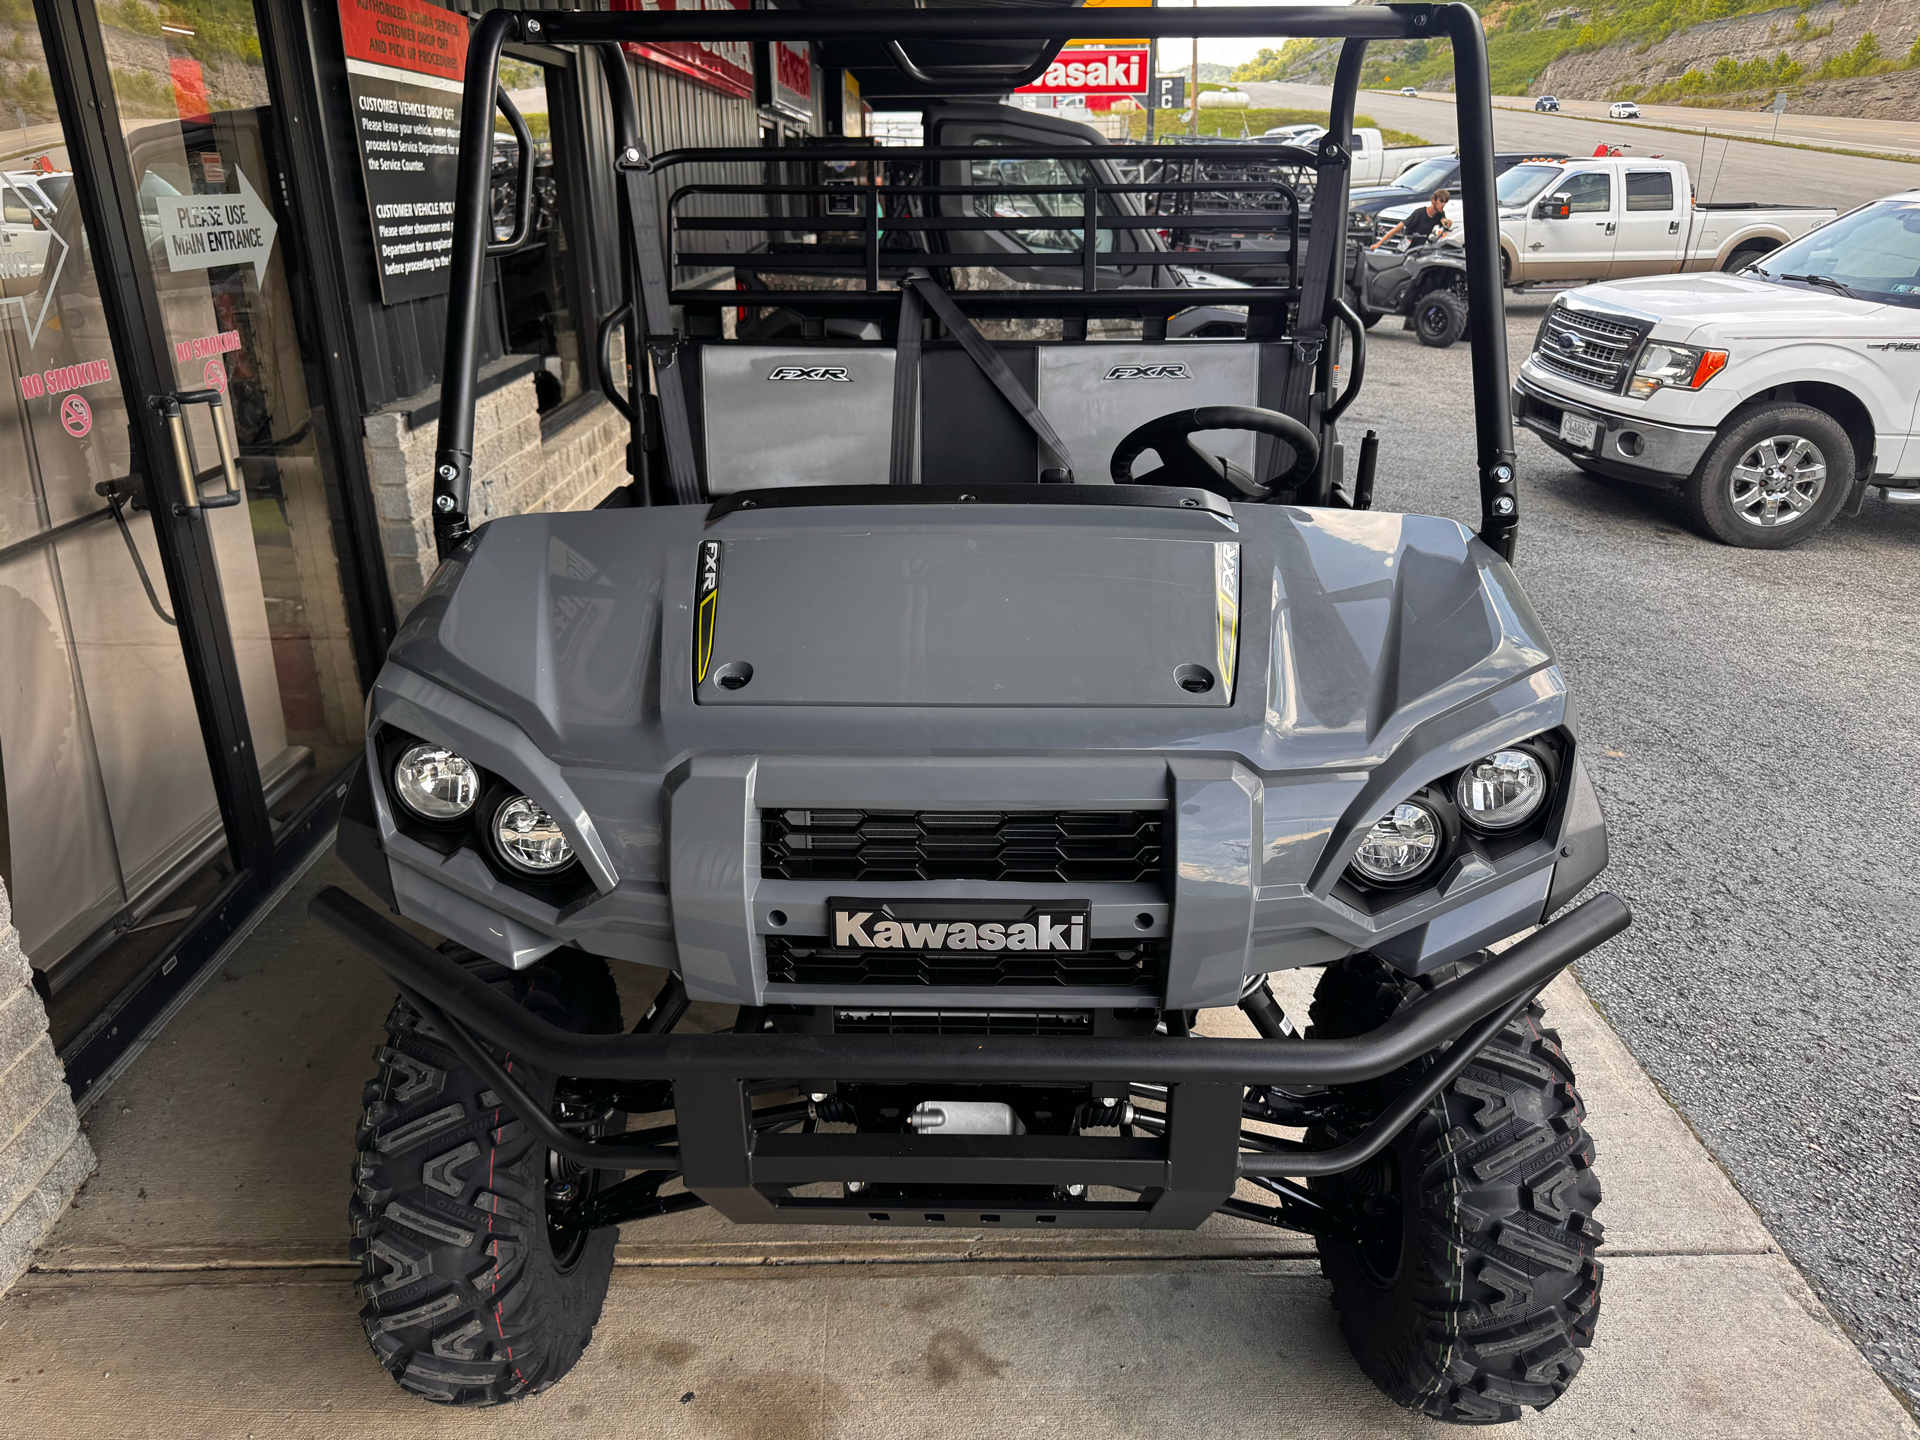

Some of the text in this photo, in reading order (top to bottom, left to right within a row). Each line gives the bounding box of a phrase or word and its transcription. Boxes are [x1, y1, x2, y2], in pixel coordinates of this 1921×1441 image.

[357, 0, 459, 36] AUTHORIZED HONDA SERVICE
[376, 20, 449, 50] CUSTOMER DROP OFF
[369, 38, 458, 70] AND PICK UP PROCEDURES
[359, 95, 455, 121] CUSTOMER VEHICLE DROP OFF
[362, 117, 382, 132] Please
[383, 120, 399, 133] leave
[399, 124, 413, 137] your
[413, 123, 433, 137] vehicle,
[433, 126, 446, 137] enter
[365, 139, 390, 153] proceed
[391, 140, 398, 152] to
[398, 140, 418, 153] Service
[418, 141, 448, 156] Department
[368, 157, 425, 171] the Service Counter.
[176, 204, 248, 229] PLEASE USE
[376, 203, 413, 218] CUSTOMER
[413, 202, 439, 216] VEHICLE
[439, 202, 453, 215] PICK
[379, 225, 398, 237] Please
[399, 224, 413, 236] enter
[414, 222, 441, 234] showroom
[441, 220, 450, 231] and
[172, 228, 264, 256] MAIN ENTRANCE
[381, 242, 416, 259] Department
[416, 241, 424, 252] for
[425, 241, 432, 251] an
[384, 262, 404, 276] before
[404, 257, 435, 276] proceeding
[434, 257, 441, 268] to
[441, 255, 449, 266] the
[175, 330, 242, 363] NO SMOKING
[20, 358, 112, 400] NO SMOKING
[767, 366, 853, 382] FXR
[1102, 363, 1191, 380] FXR
[702, 542, 719, 594] FXR
[1221, 542, 1237, 602] FXR
[835, 910, 1084, 951] Kawasaki
